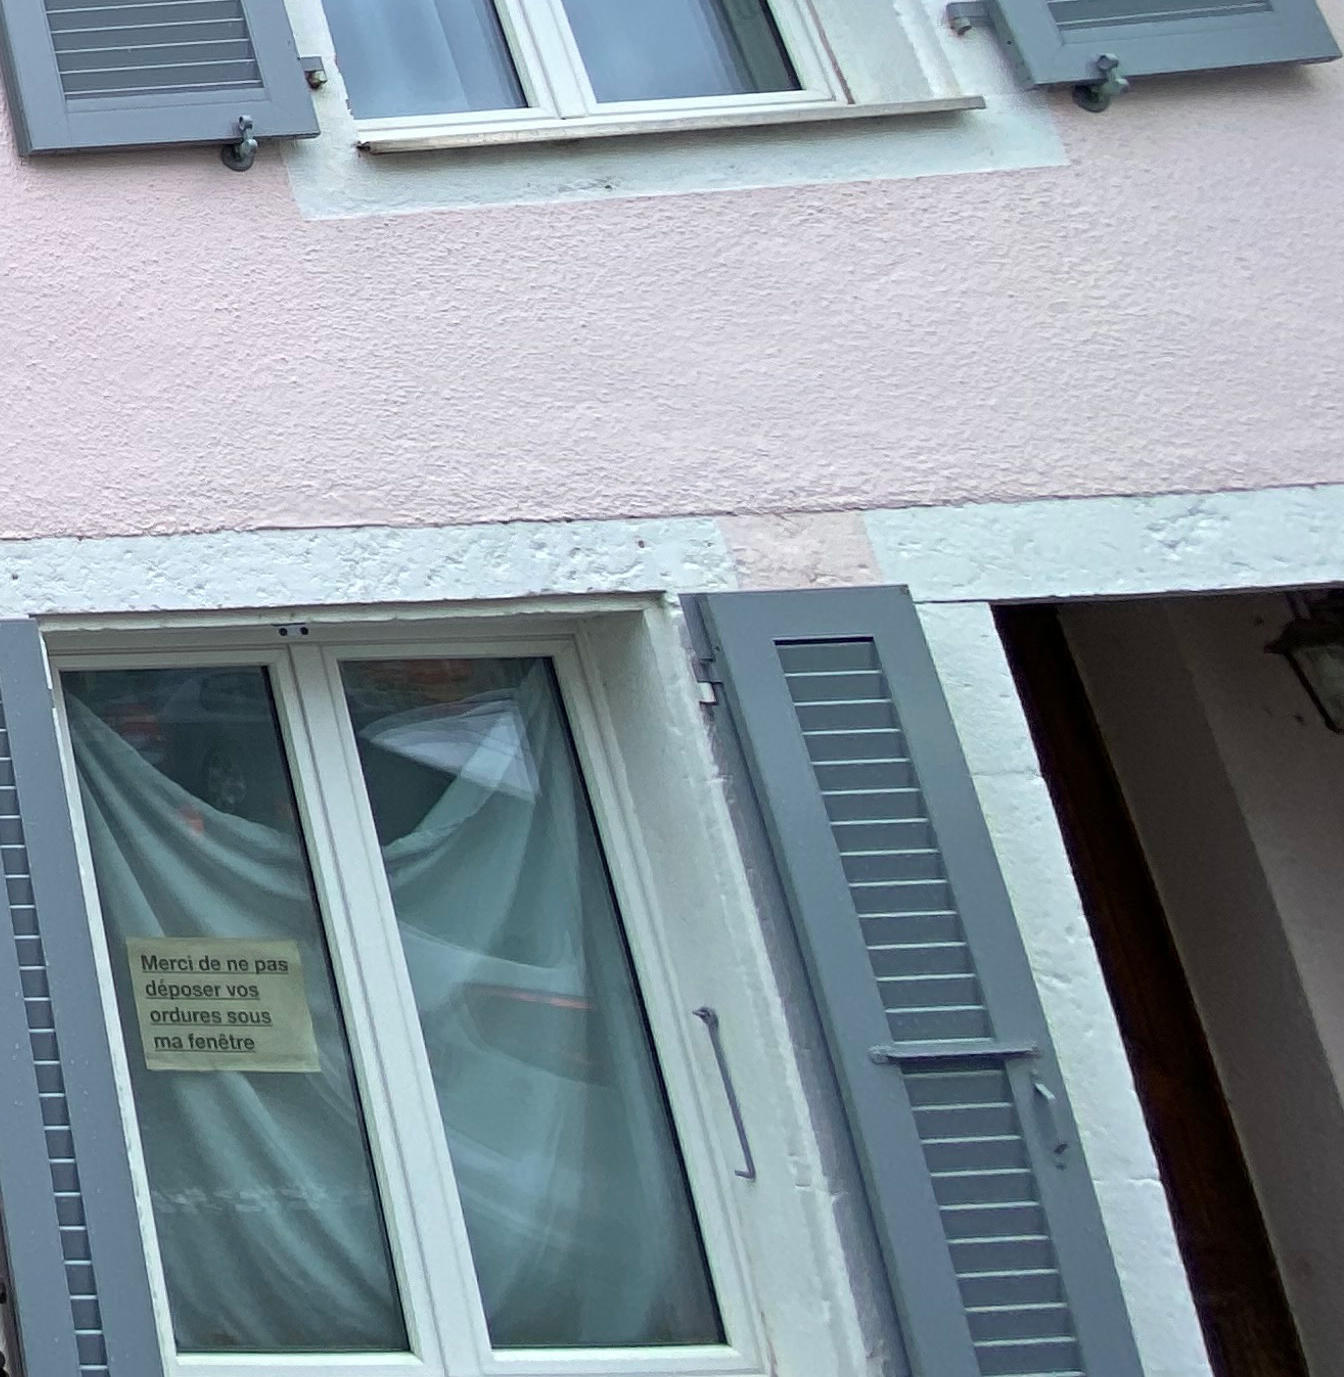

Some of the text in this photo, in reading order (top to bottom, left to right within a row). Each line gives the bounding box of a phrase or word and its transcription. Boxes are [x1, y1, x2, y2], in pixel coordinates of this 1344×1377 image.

[140, 954, 289, 975] Merci de ne pas
[145, 978, 260, 1000] déposer vos
[149, 1007, 273, 1024] ordures sous
[154, 1033, 256, 1050] ma fenêtre
